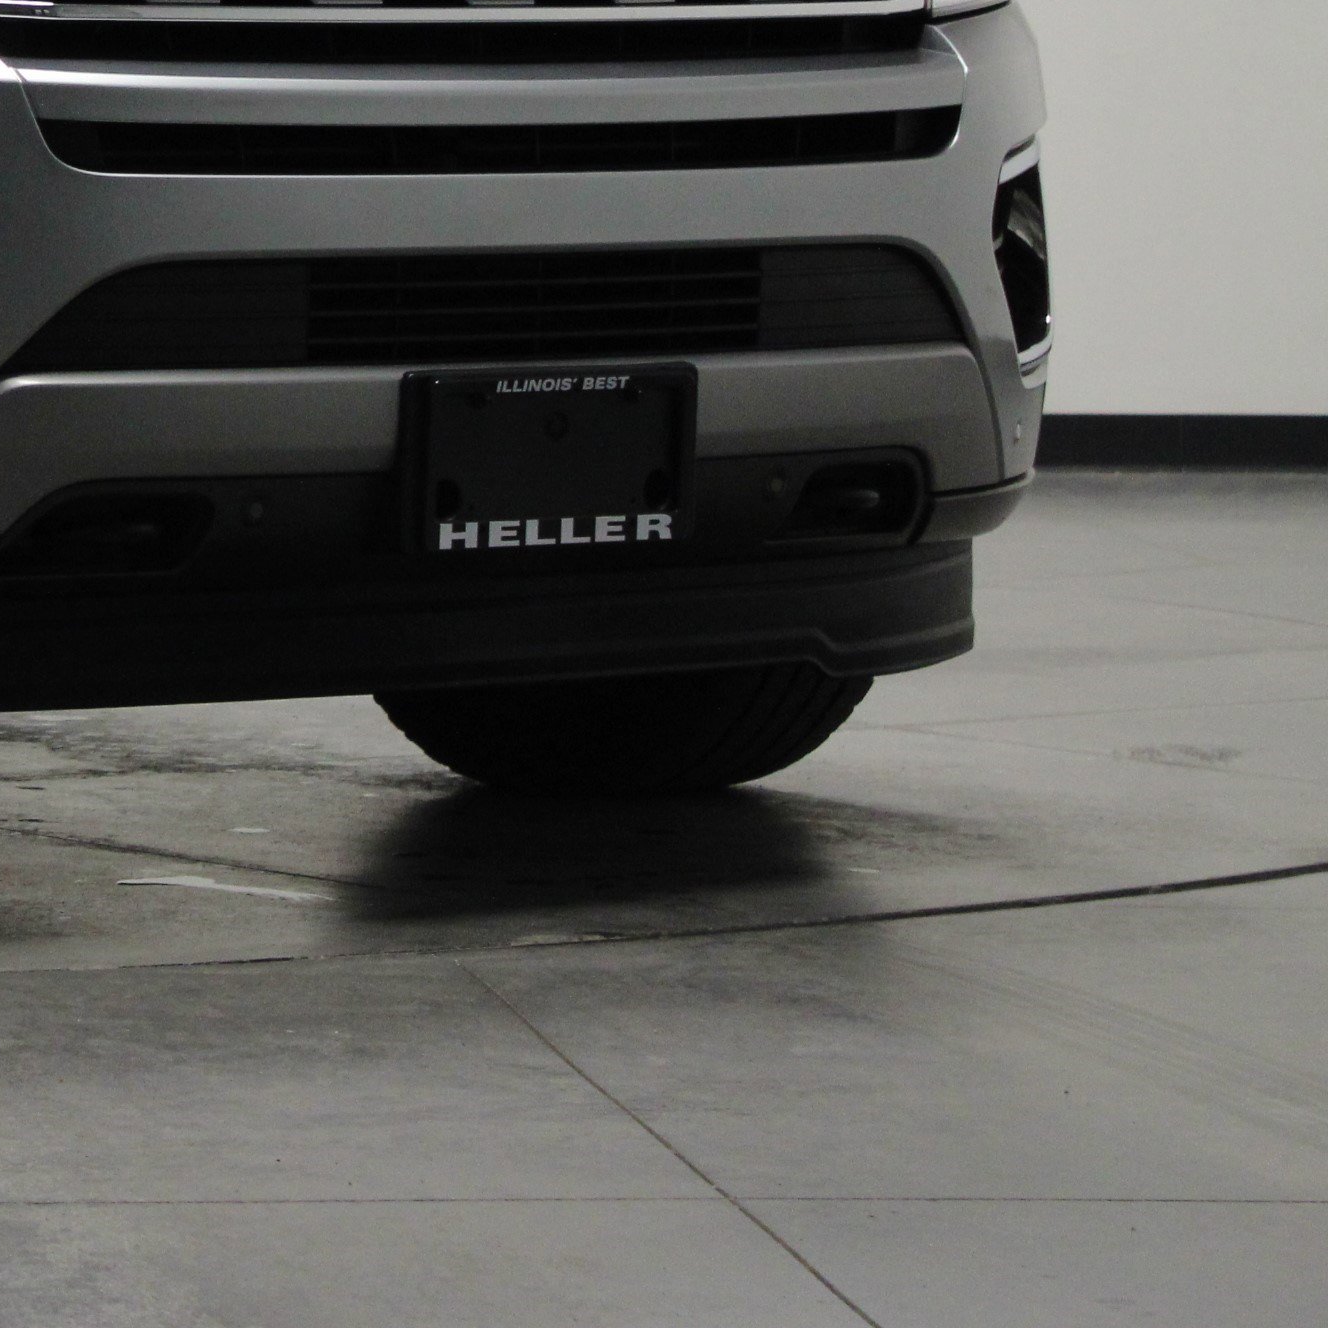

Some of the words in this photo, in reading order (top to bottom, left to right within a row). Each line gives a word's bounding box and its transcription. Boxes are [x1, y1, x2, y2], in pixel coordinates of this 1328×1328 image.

[496, 377, 578, 394] ILLINOIS'
[582, 375, 630, 391] BEST
[438, 513, 673, 550] HELLER
